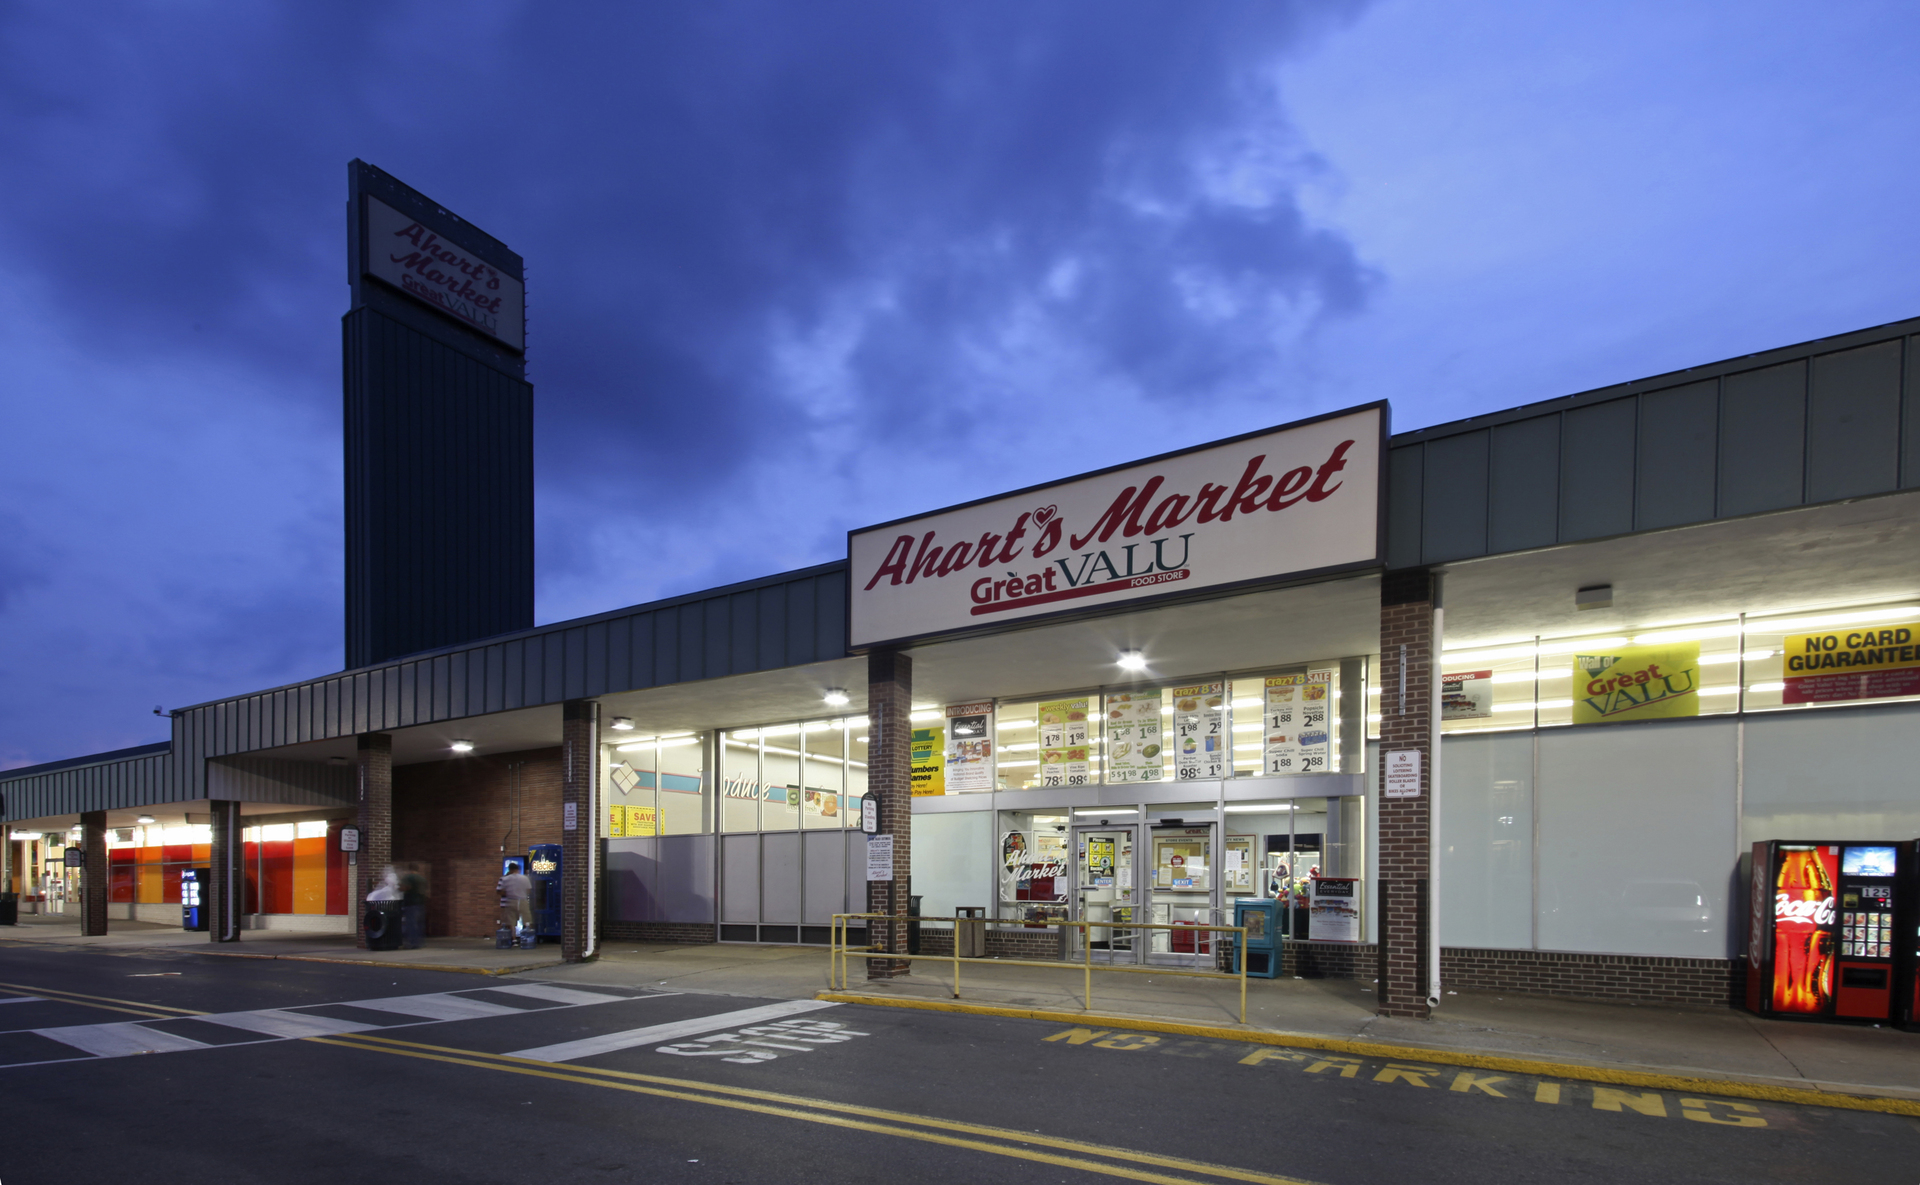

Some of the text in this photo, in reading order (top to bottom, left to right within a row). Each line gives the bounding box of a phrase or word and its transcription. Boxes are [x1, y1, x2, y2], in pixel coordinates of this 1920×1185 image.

[390, 252, 502, 314] Market
[444, 292, 498, 330] VALU
[1069, 439, 1356, 550] Market
[1054, 533, 1194, 588] VALU
[1131, 570, 1184, 587] FOOD STORE
[1806, 628, 1911, 653] NO CARD
[1578, 655, 1614, 670] Wall of
[1308, 672, 1330, 684] SALE
[1212, 682, 1232, 693] SAE
[1582, 668, 1693, 714] VALU
[946, 704, 991, 716] INTRODUCING
[1045, 702, 1070, 712] weekly
[634, 812, 656, 822] SAVE
[531, 860, 557, 871] Glacier
[1002, 862, 1065, 883] Market
[1320, 882, 1350, 890] Essential
[1040, 1027, 1768, 1128] NO PARKING
